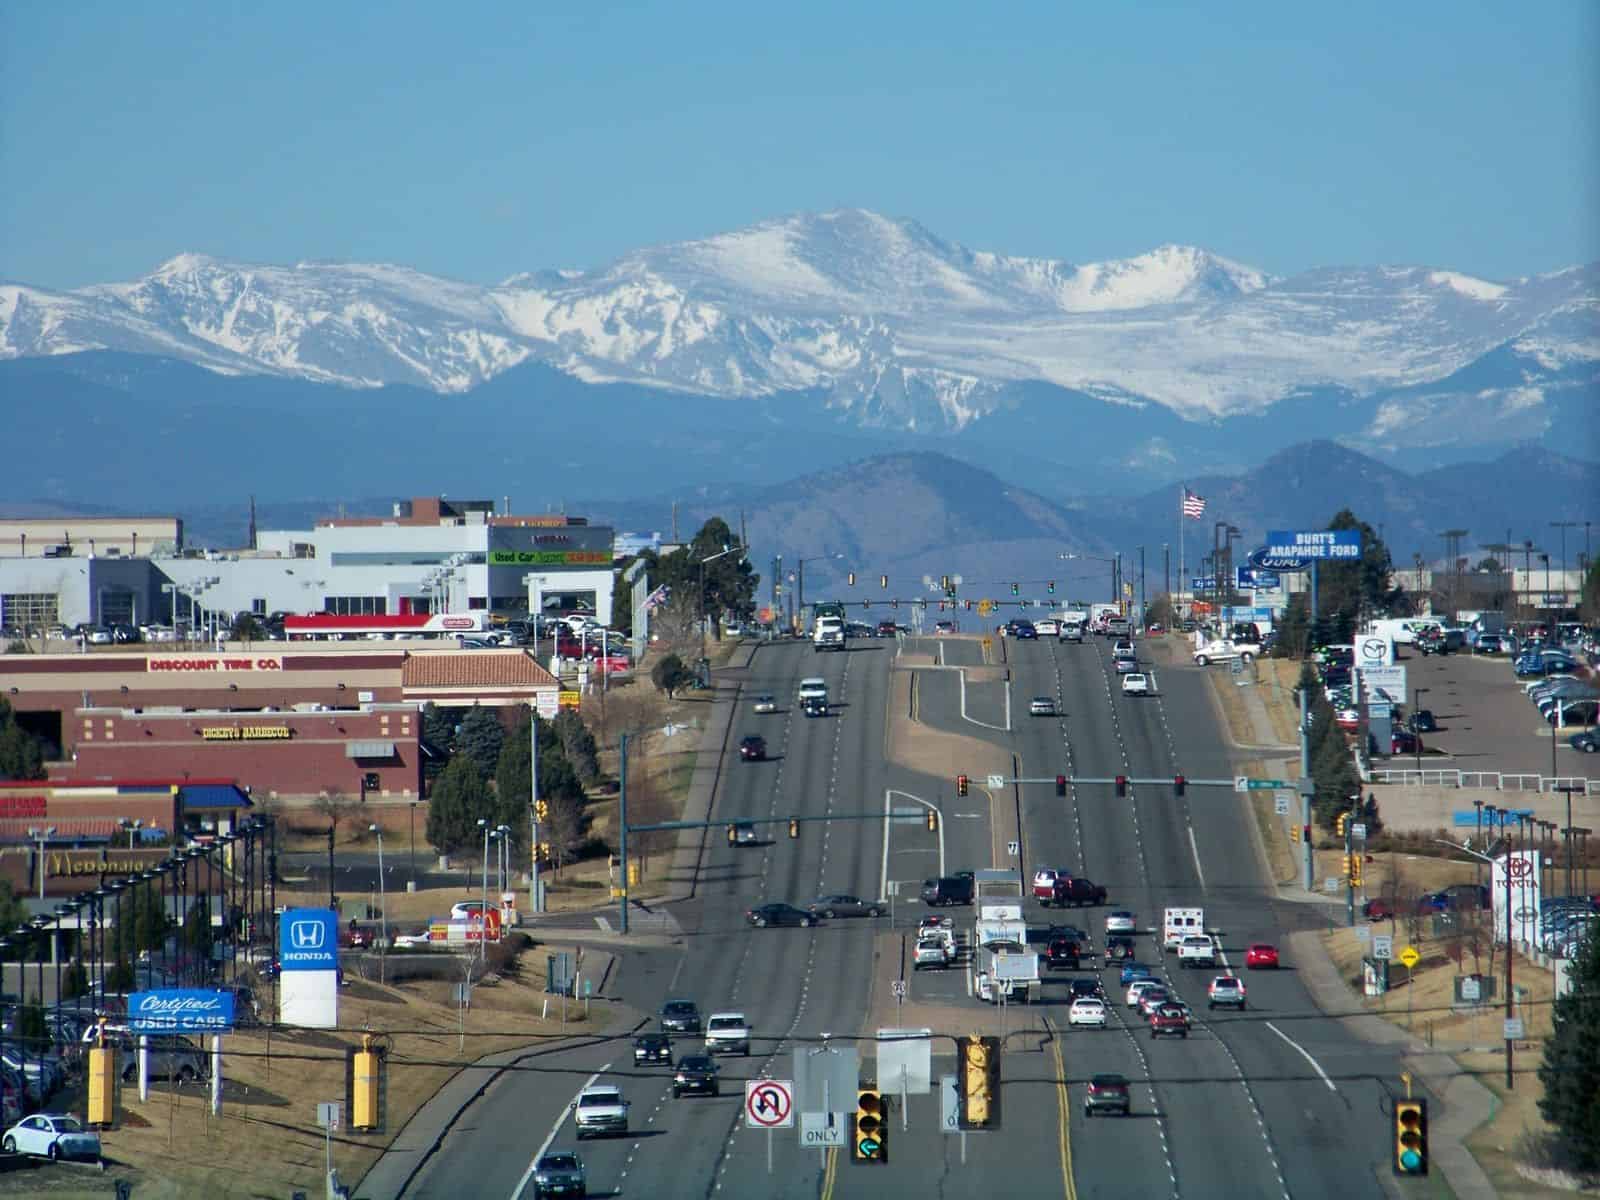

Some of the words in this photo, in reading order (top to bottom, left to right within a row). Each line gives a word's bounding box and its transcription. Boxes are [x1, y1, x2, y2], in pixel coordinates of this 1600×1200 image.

[1296, 533, 1336, 544] BURT'S
[495, 552, 515, 562] Used
[518, 552, 535, 562] Car
[1270, 545, 1326, 557] ARAPAHOE
[1329, 545, 1359, 557] FORD
[150, 660, 219, 671] DISCOUNT
[222, 660, 252, 670] TIRE
[257, 659, 280, 670] CO.
[1496, 879, 1538, 889] TOYOTA
[284, 952, 333, 961] HONDA
[140, 995, 222, 1015] Certified
[134, 1016, 177, 1029] USED
[182, 1016, 226, 1029] CARS
[806, 1130, 839, 1142] ONLY
